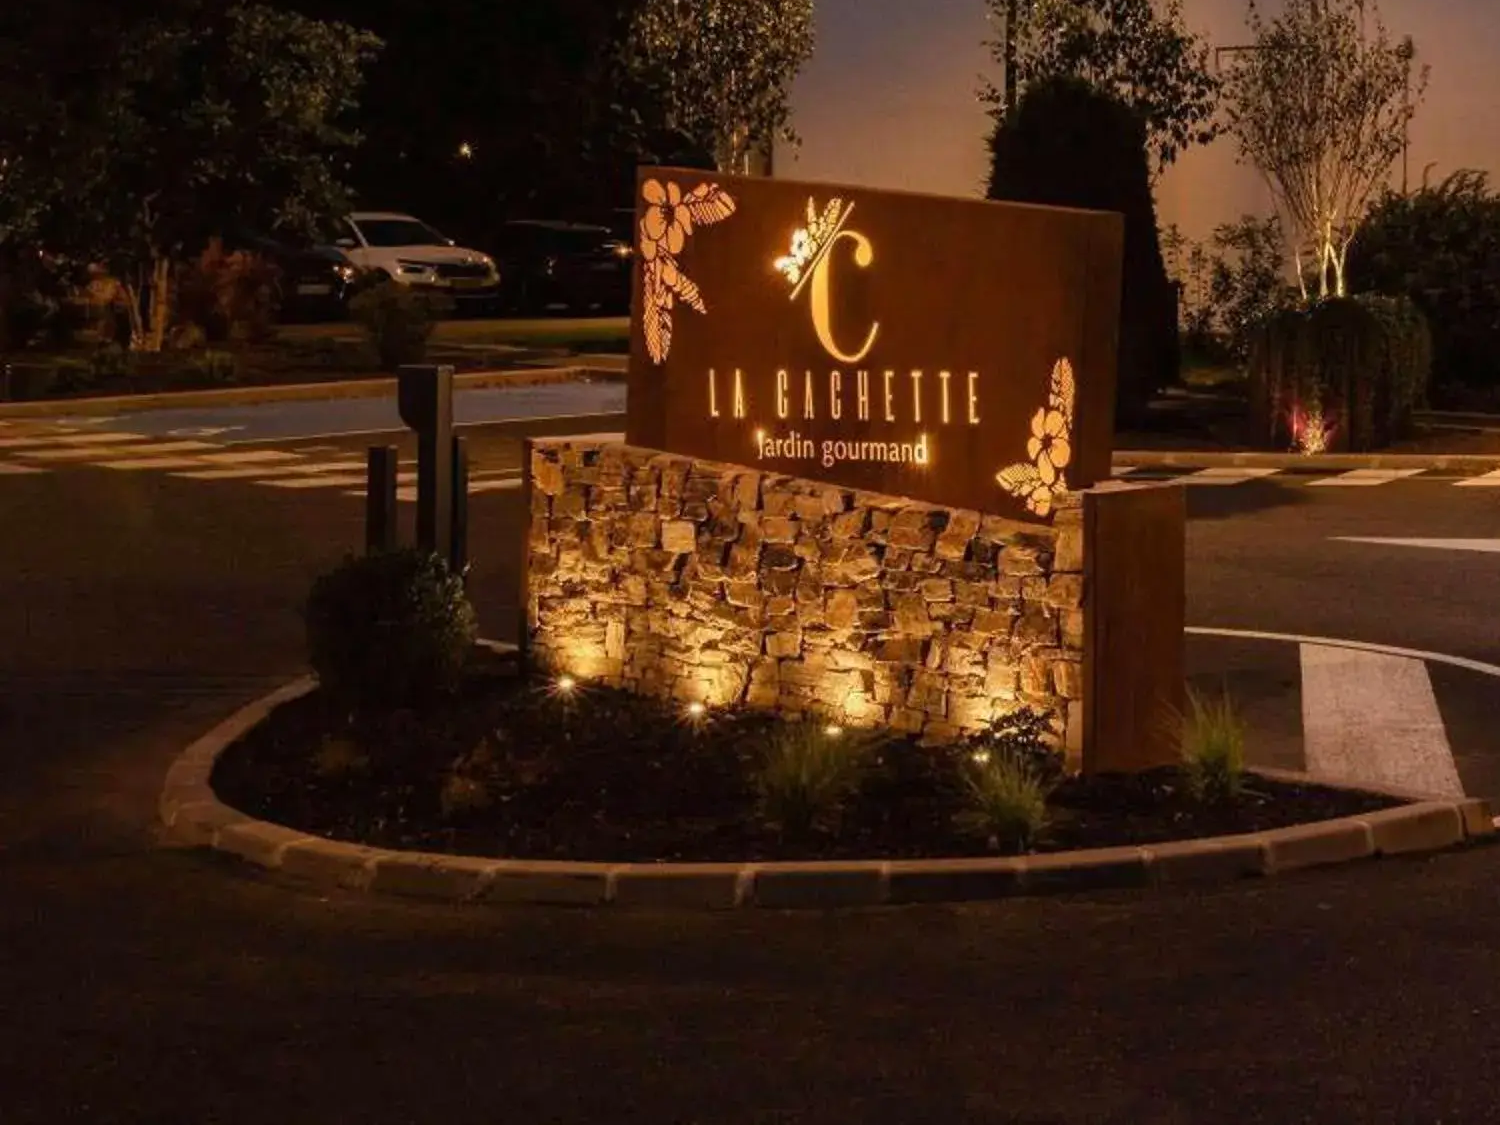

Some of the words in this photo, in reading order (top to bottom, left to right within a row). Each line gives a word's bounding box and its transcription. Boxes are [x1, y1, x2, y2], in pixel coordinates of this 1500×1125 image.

[811, 229, 879, 364] C
[708, 368, 746, 419] LA
[776, 369, 981, 424] CACHETTE
[821, 432, 929, 468] gourmand
